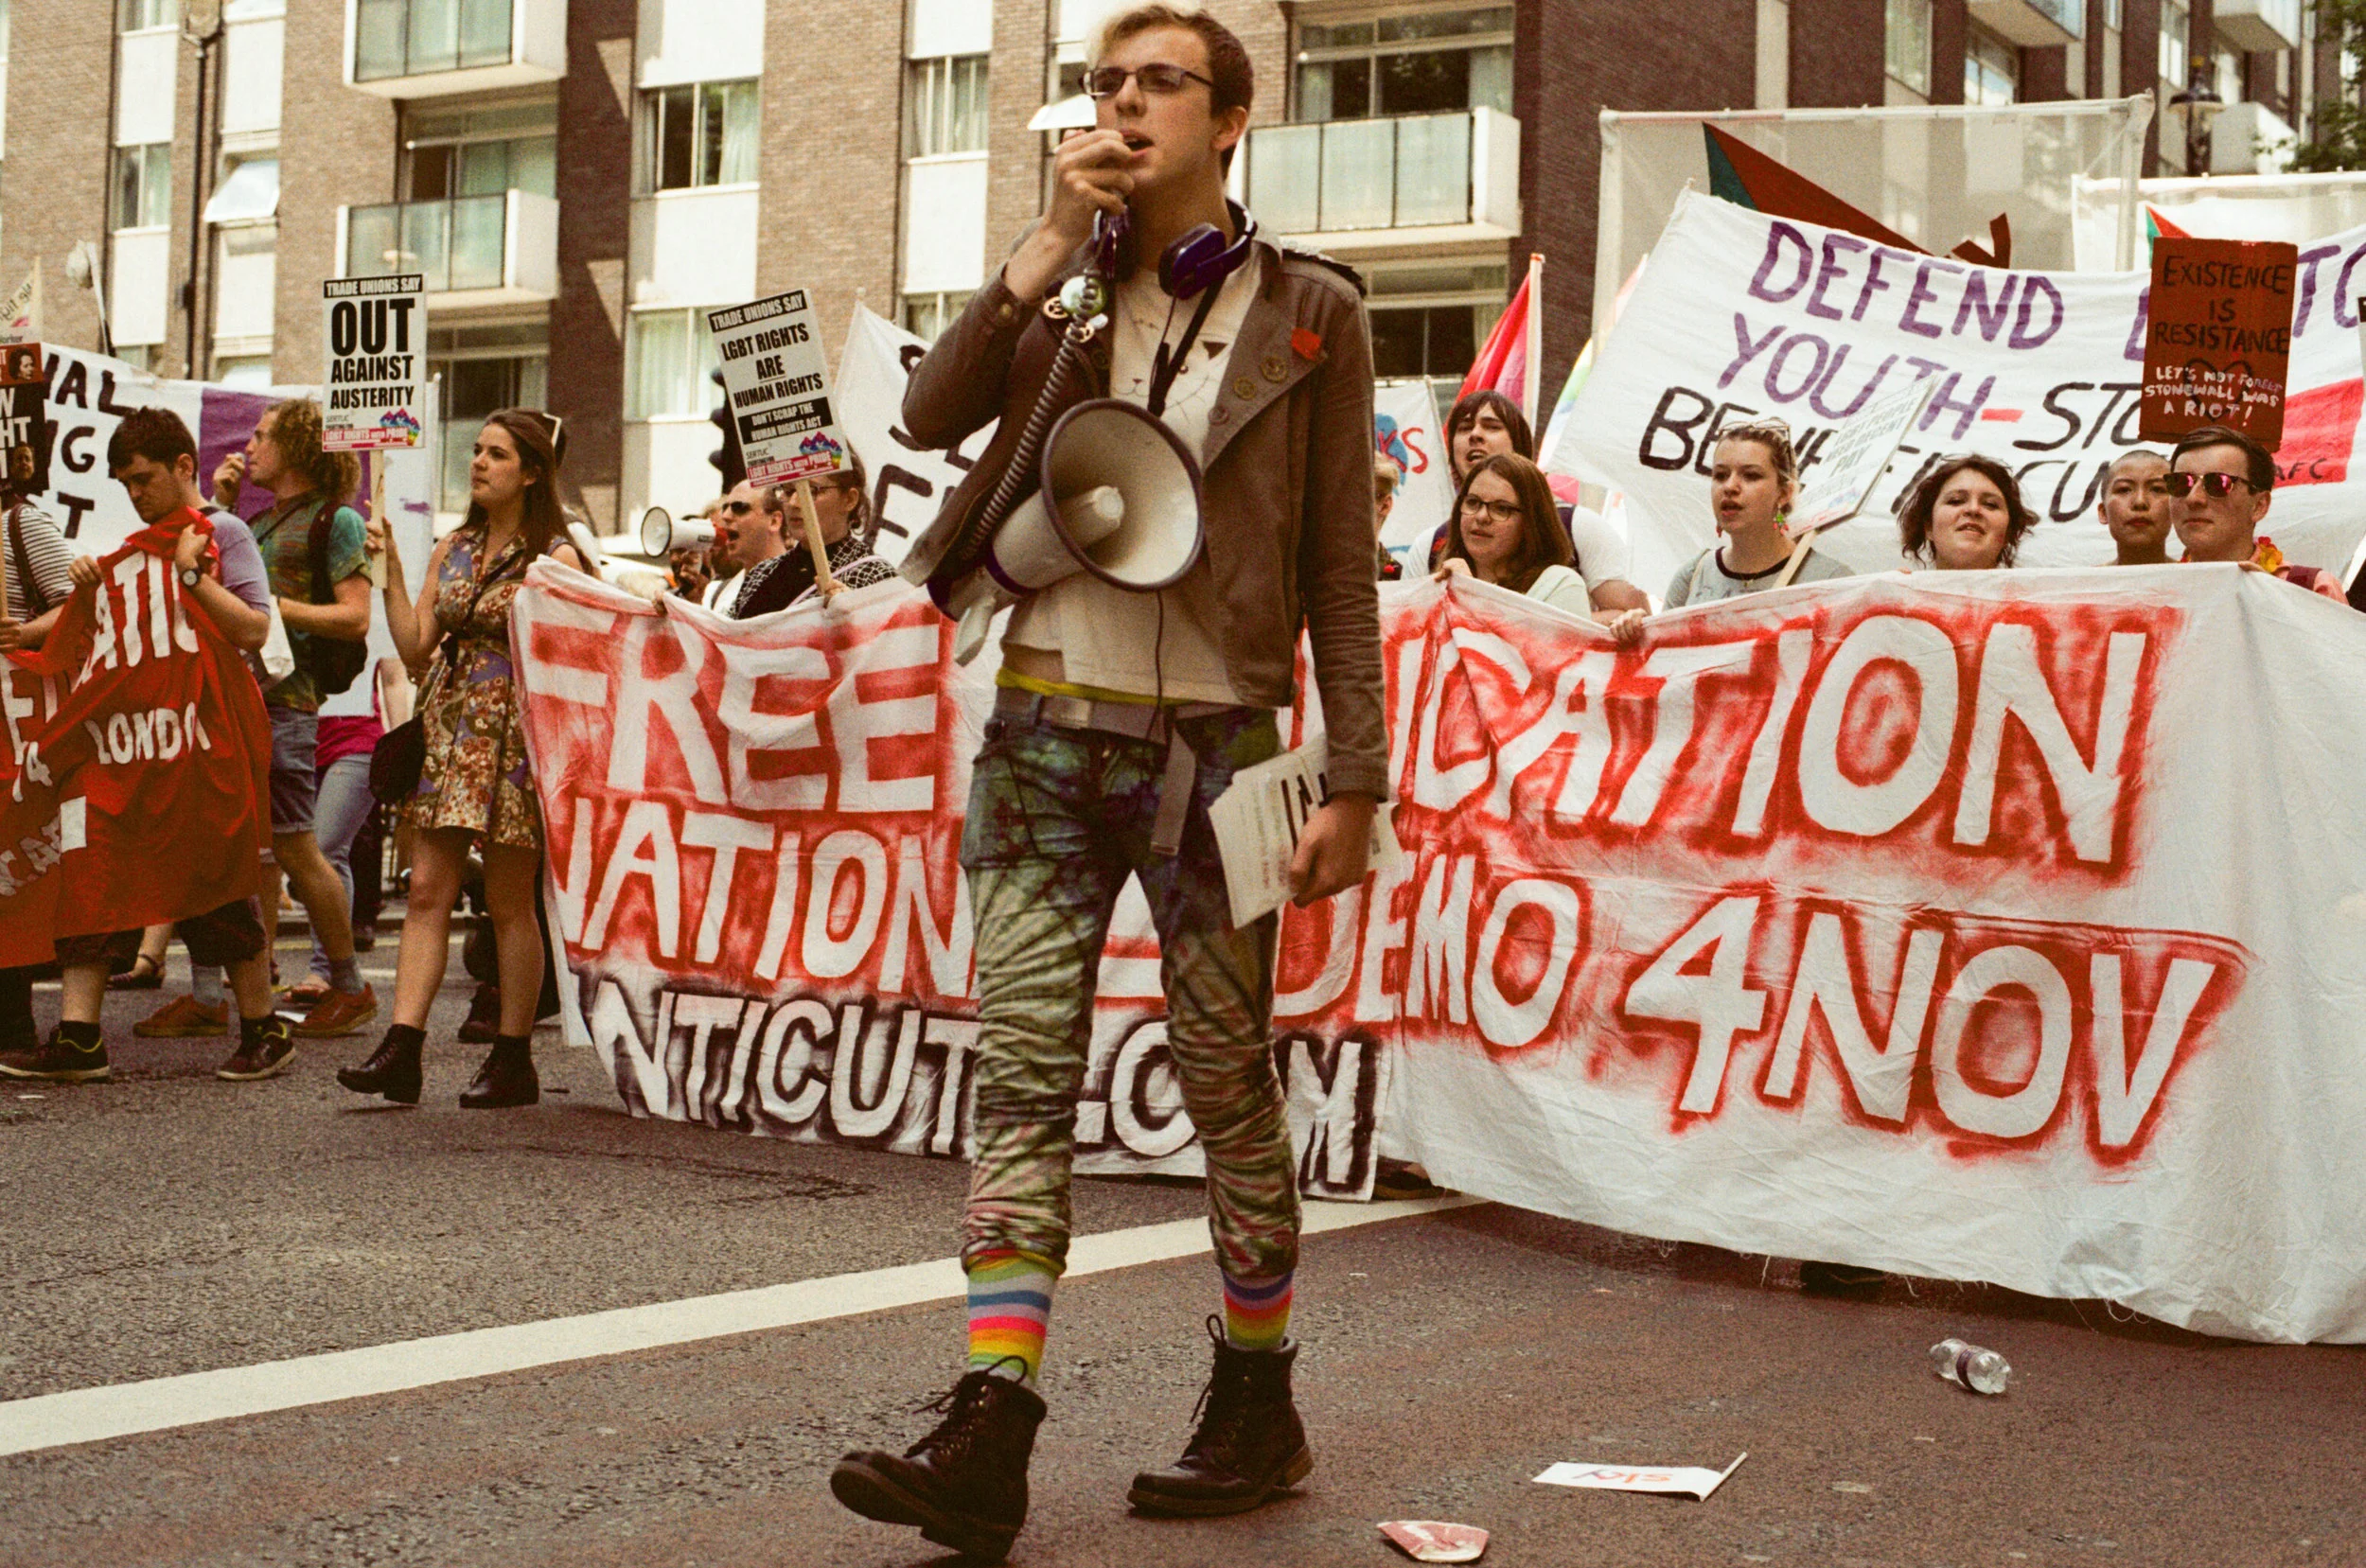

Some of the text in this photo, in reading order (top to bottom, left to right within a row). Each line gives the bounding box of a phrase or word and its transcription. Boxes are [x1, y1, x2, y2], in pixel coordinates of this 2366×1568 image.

[327, 276, 420, 296] TRADE UNIONS SAY
[1748, 220, 2064, 351] DEFEND
[2163, 255, 2291, 293] EXISTENCE
[711, 292, 805, 329] TRADE UNIONS SAY
[2209, 298, 2235, 322] IS
[332, 298, 415, 356] OUT
[2154, 322, 2289, 354] RESISTANCE
[720, 323, 810, 361] LGBT RIGHTS
[331, 356, 414, 383] AGAINST
[754, 355, 786, 379] ARE
[2156, 366, 2196, 380] LET'S
[2204, 371, 2234, 382] NOT
[330, 386, 415, 409] AUSTERITY
[733, 372, 823, 409] HUMAN RIGHTS
[2145, 384, 2279, 407] STONEWALL WAS
[772, 406, 798, 421] SCRAP
[799, 402, 814, 415] THE
[776, 419, 805, 436] RIGHTS
[805, 415, 822, 429] ACT
[2013, 381, 2142, 451] STO
[2164, 400, 2252, 427] A RIOT!
[520, 589, 940, 814] FREE
[1386, 614, 2146, 864] CATION
[1272, 854, 1580, 1047] DEMO
